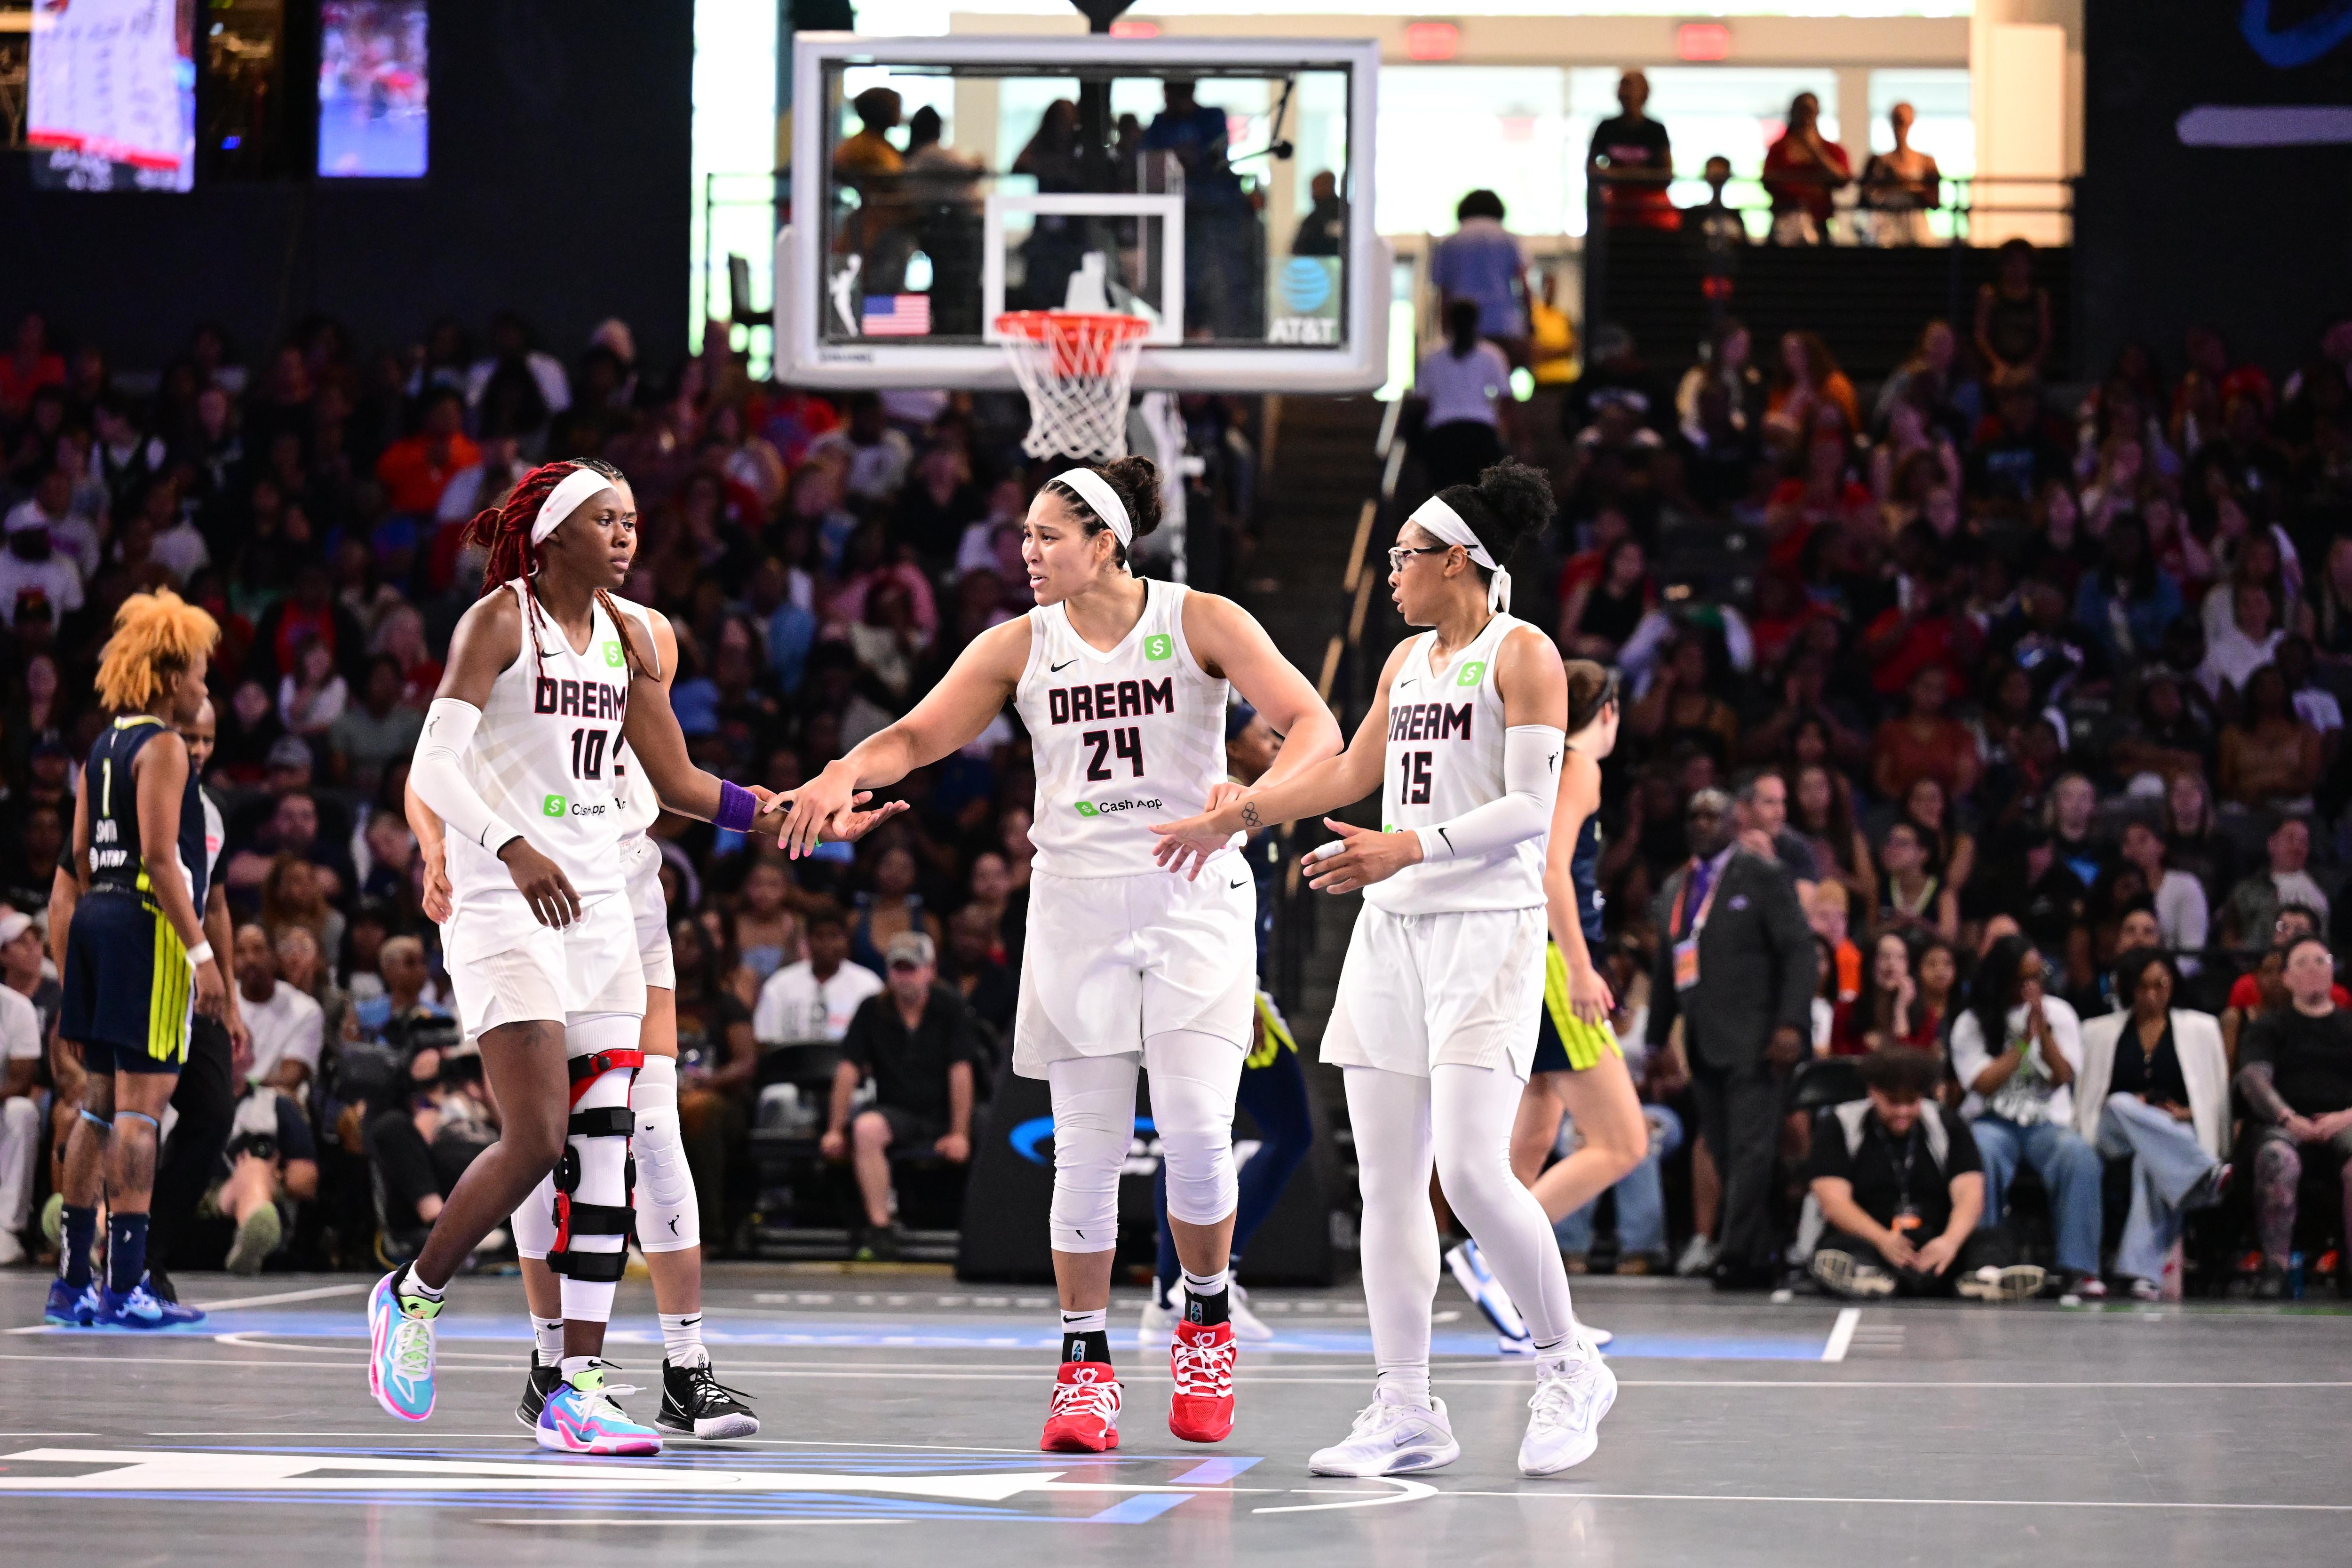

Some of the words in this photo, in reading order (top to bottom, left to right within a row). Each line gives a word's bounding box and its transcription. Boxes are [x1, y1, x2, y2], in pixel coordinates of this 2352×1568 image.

[1268, 318, 1338, 344] AT&T
[534, 676, 626, 723] DREAM
[1048, 677, 1175, 725] DREAM
[571, 728, 608, 780] 10
[1082, 726, 1144, 782] 24
[1401, 751, 1432, 805] 15
[102, 757, 111, 819] 1
[1099, 799, 1134, 813] Cash
[1136, 798, 1163, 809] App
